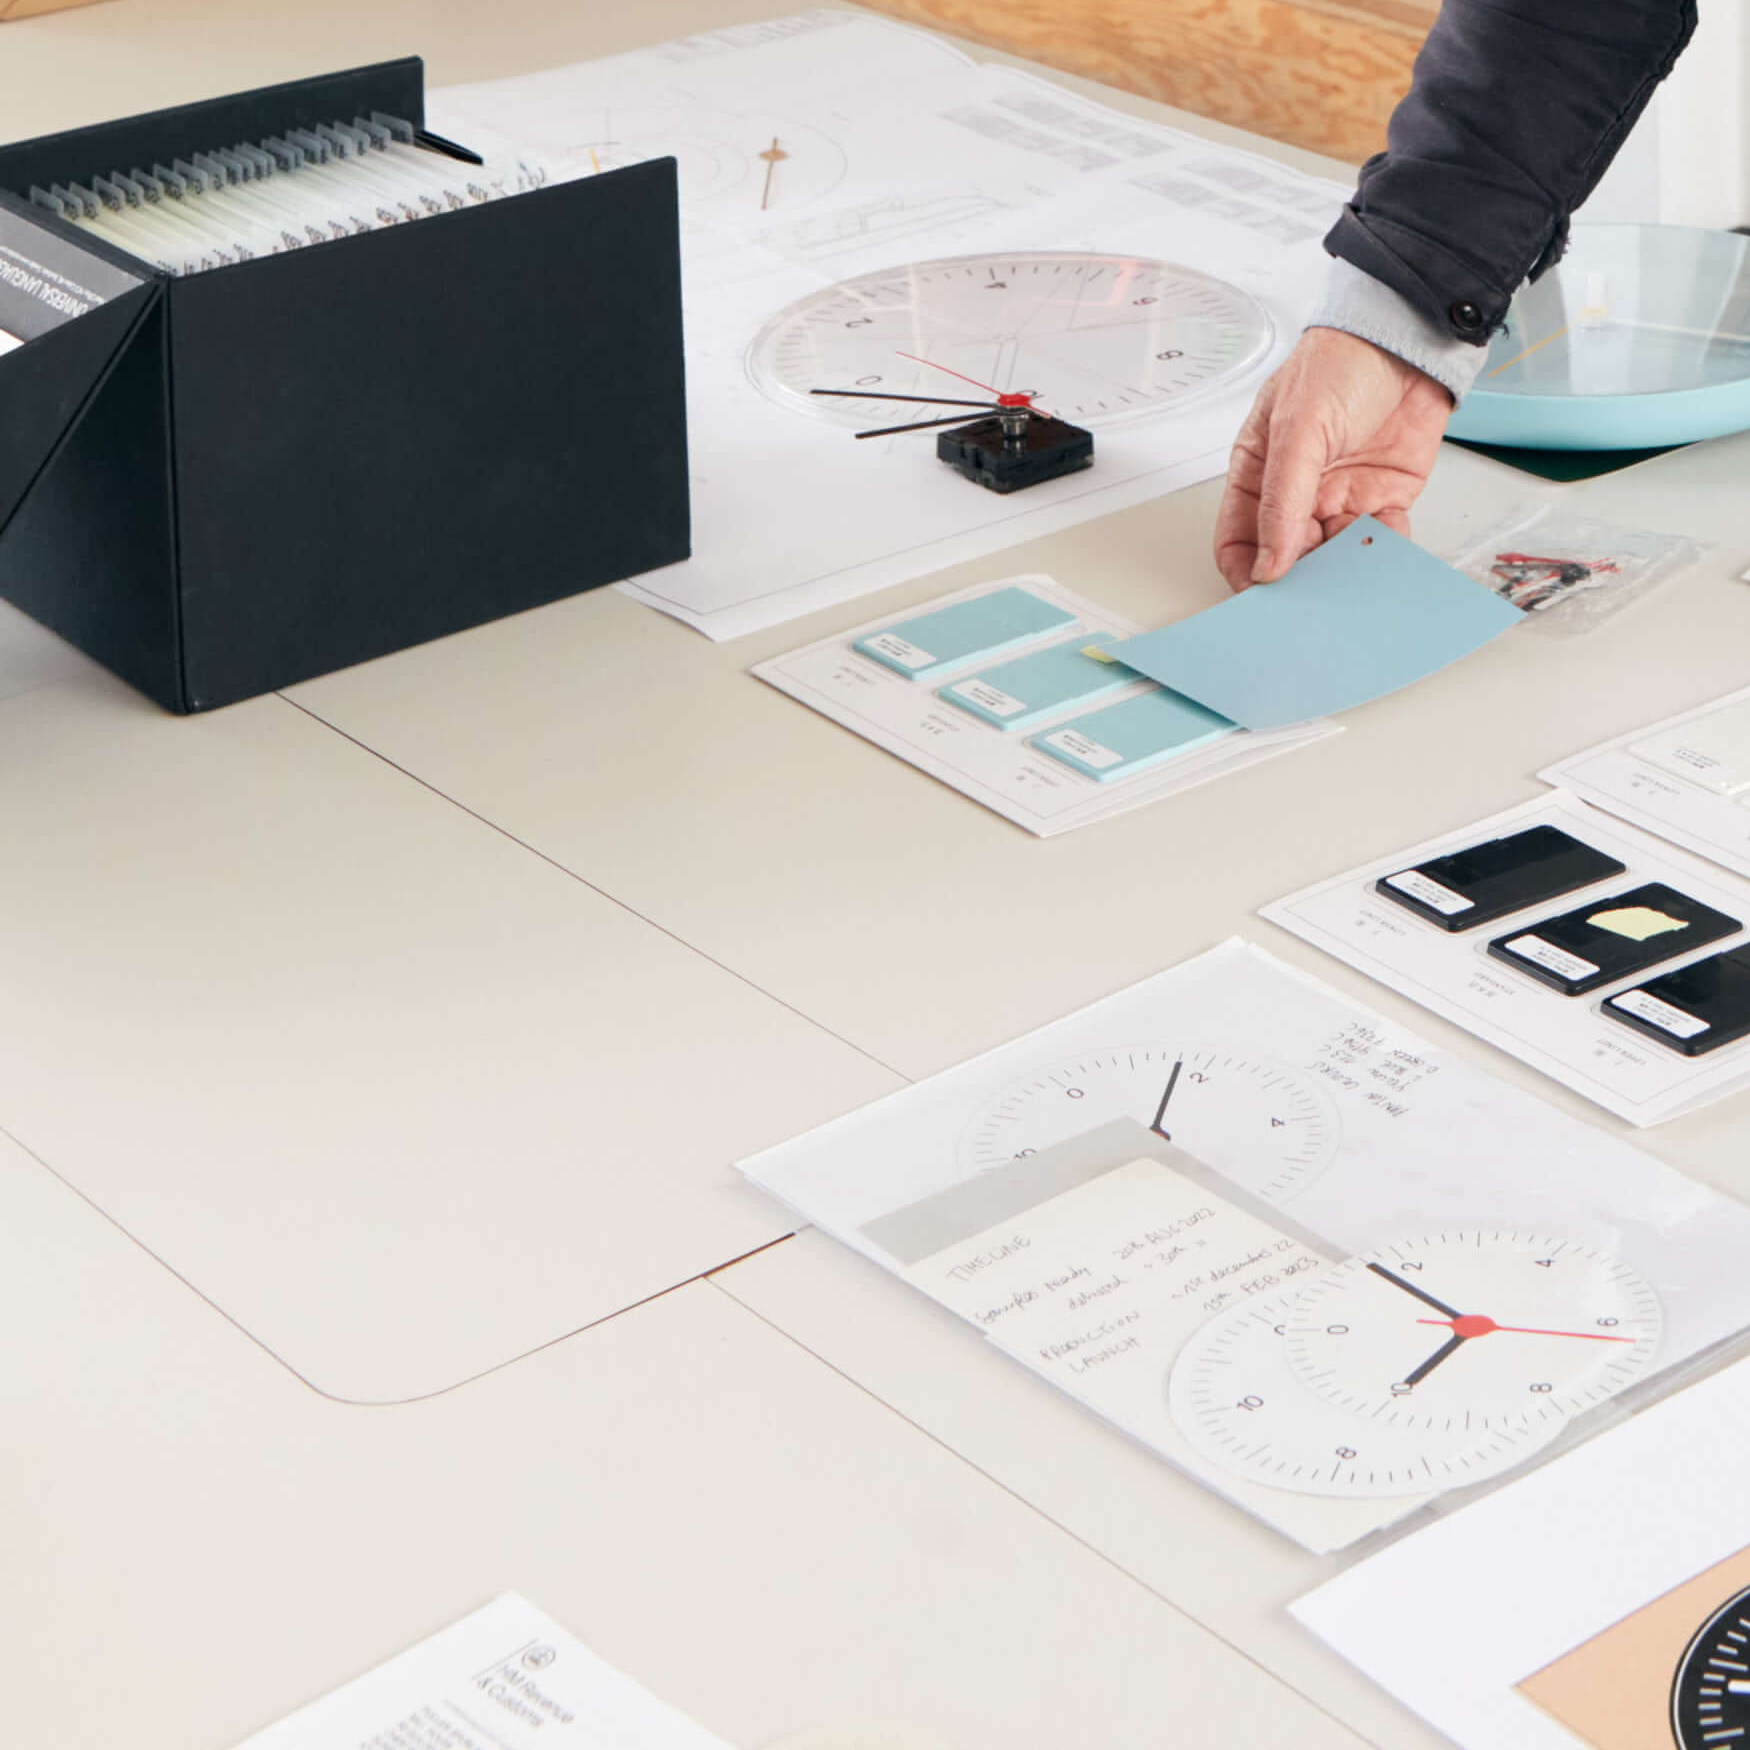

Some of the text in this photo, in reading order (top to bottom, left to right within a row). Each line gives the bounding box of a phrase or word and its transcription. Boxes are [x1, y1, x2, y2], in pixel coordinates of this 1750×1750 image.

[1189, 1071, 1210, 1084] 2
[1066, 1087, 1085, 1100] 0
[1271, 1116, 1286, 1128] 4
[946, 1235, 1032, 1284] TIMELINE
[1401, 1260, 1425, 1271] 2
[1534, 1258, 1555, 1268] 4
[1069, 1334, 1141, 1375] LAUNCH
[1241, 1271, 1281, 1296] FEB
[1596, 1316, 1620, 1329] 6
[1039, 1310, 1141, 1362] PRODUCTION
[1326, 1323, 1350, 1336] 0
[1528, 1381, 1554, 1396] 8
[1236, 1394, 1265, 1414] 10
[1334, 1445, 1359, 1462] 8
